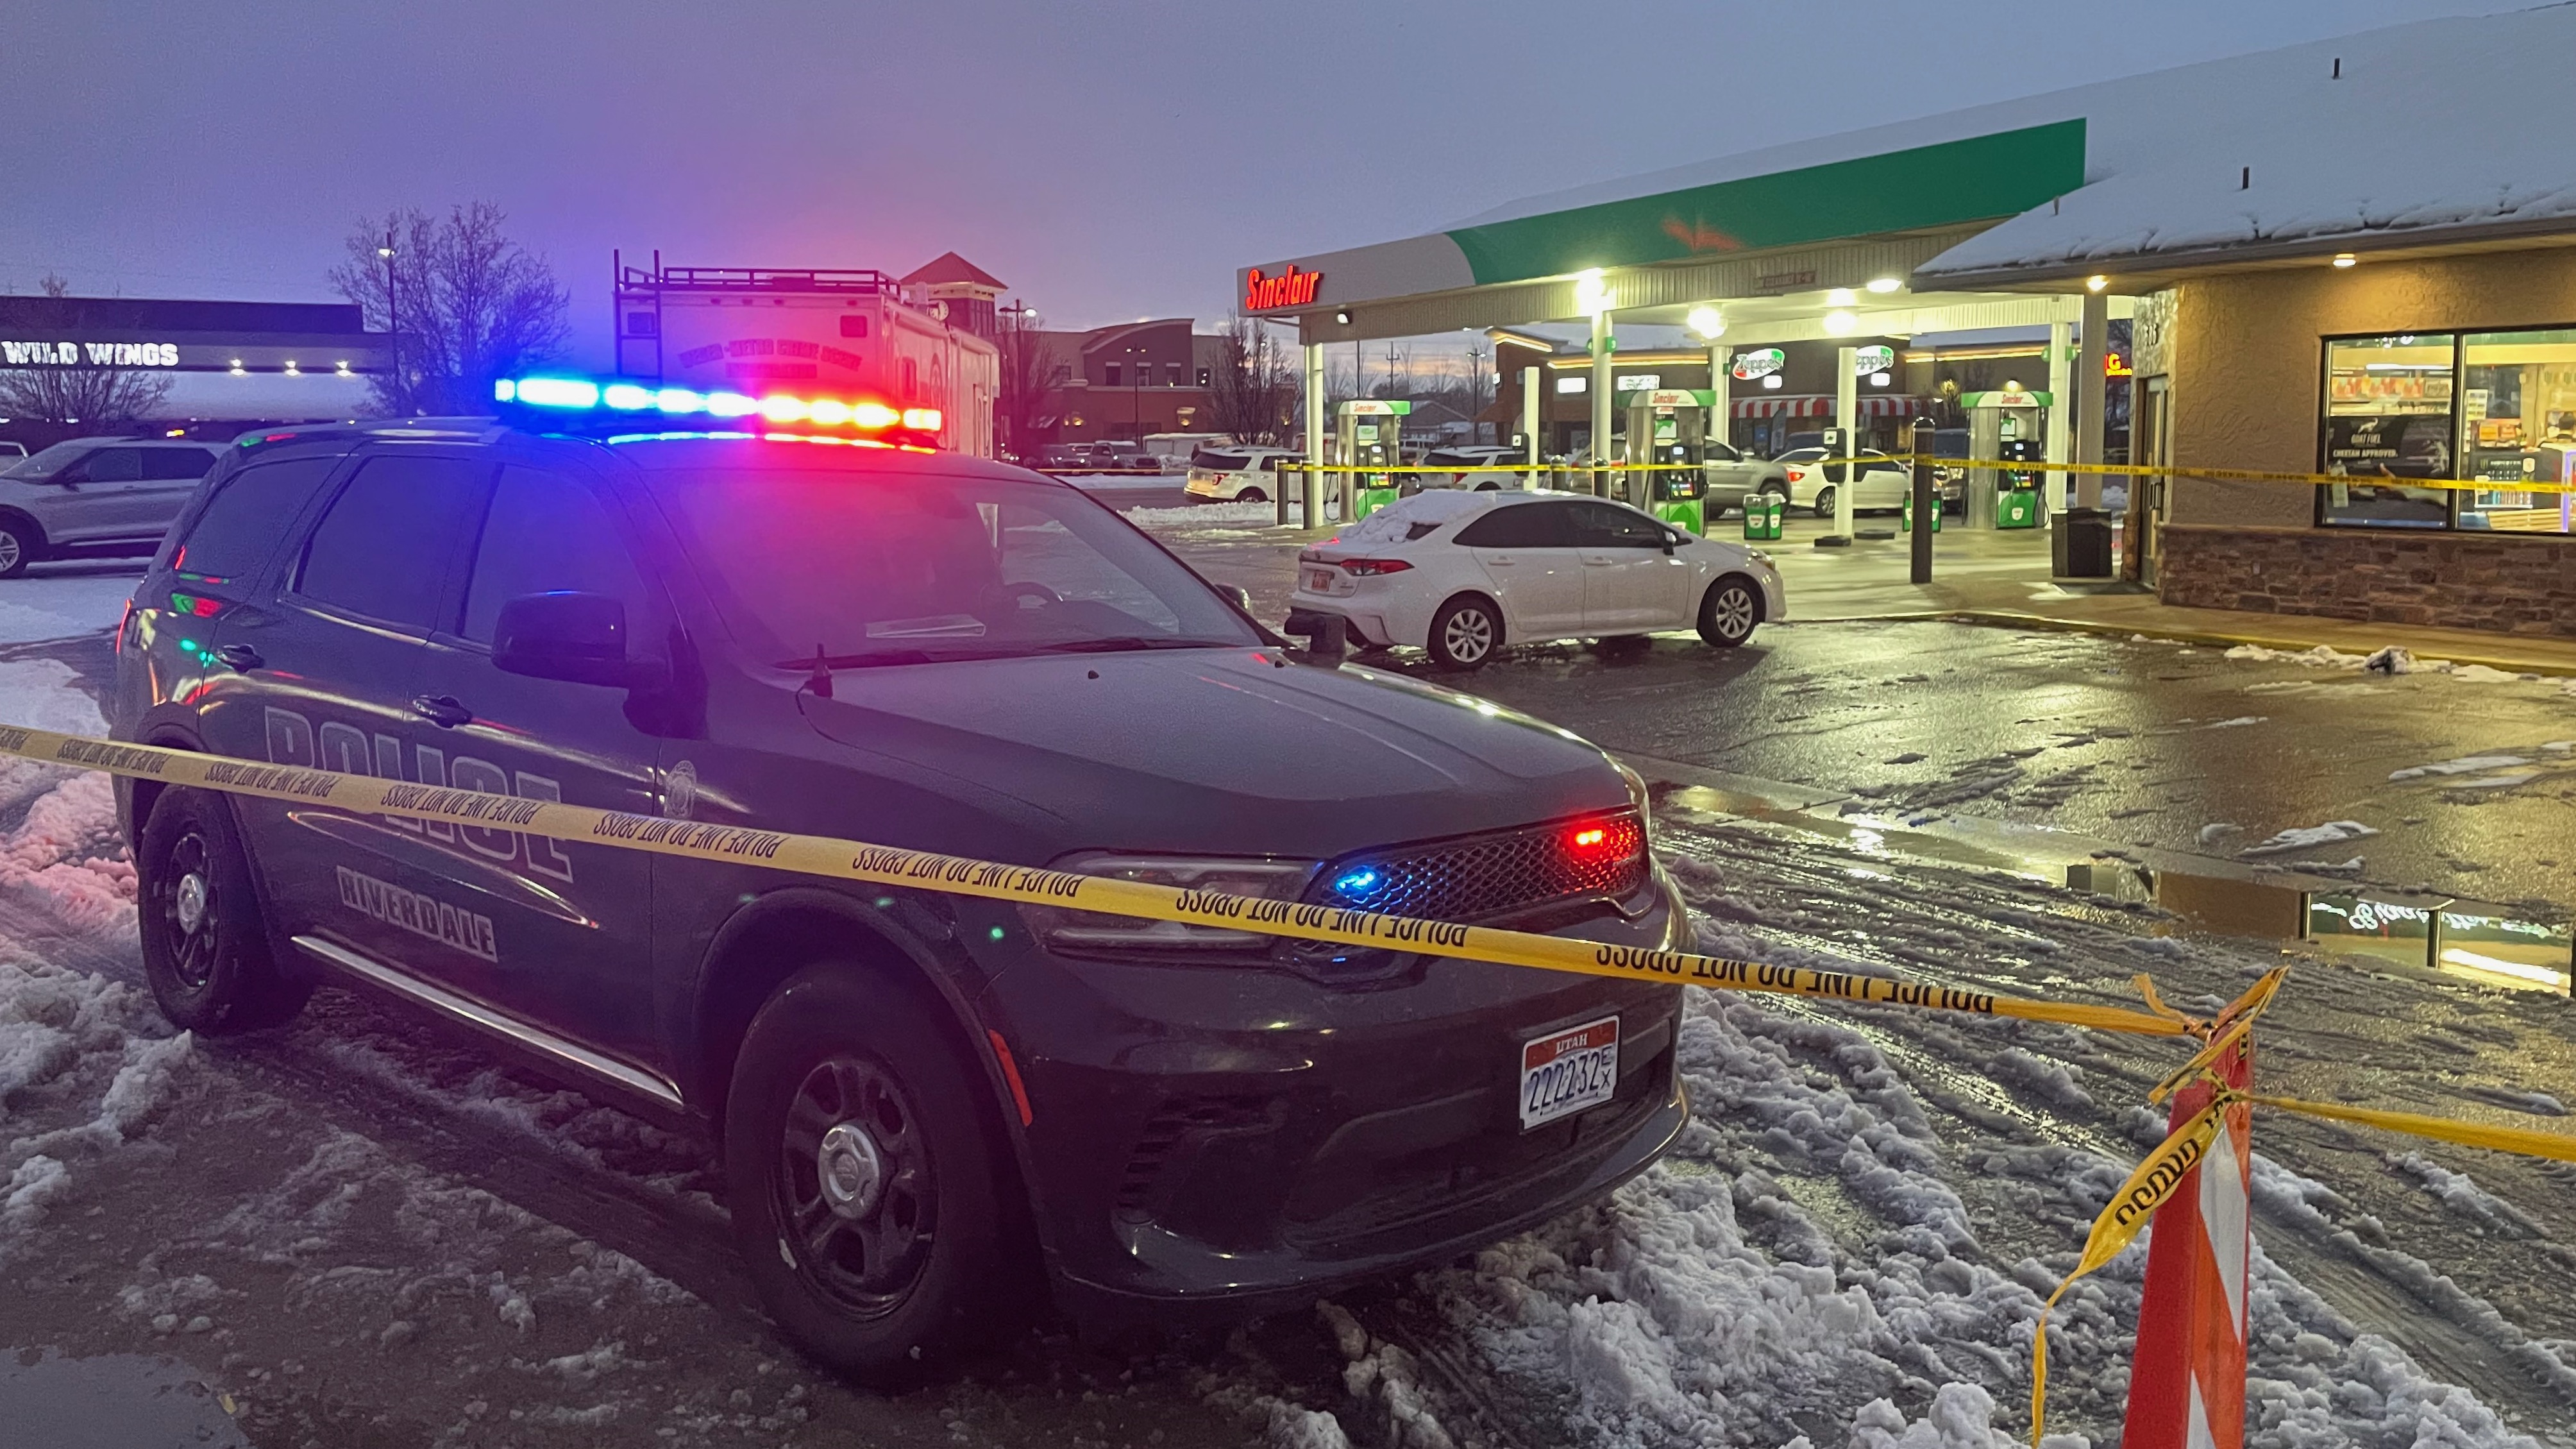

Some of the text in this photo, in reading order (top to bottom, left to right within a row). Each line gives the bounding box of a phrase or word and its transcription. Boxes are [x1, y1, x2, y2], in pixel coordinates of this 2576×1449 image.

[1245, 264, 1320, 310] Sinclair
[1, 341, 179, 366] WILD WINGS
[1653, 392, 1679, 404] Sinclair
[205, 761, 343, 798] POLICE LINE DO NOT CROSS
[380, 784, 546, 826] POLICE LINE DO NOT CROSS
[593, 812, 791, 859] POLICE LINE DO NOT CROSS
[852, 846, 1088, 898] POLICE LINE DO NOT CROSS
[337, 865, 499, 963] RIVERDALE
[1175, 888, 1246, 918] CROSS
[1246, 898, 1292, 924] NOT
[1295, 902, 1327, 928] DO
[1384, 916, 1469, 947] POLICE
[1691, 958, 1749, 983] NOT
[1758, 963, 1796, 983] DO
[1555, 1033, 1588, 1055] UTAH
[1529, 1051, 1599, 1114] 222232
